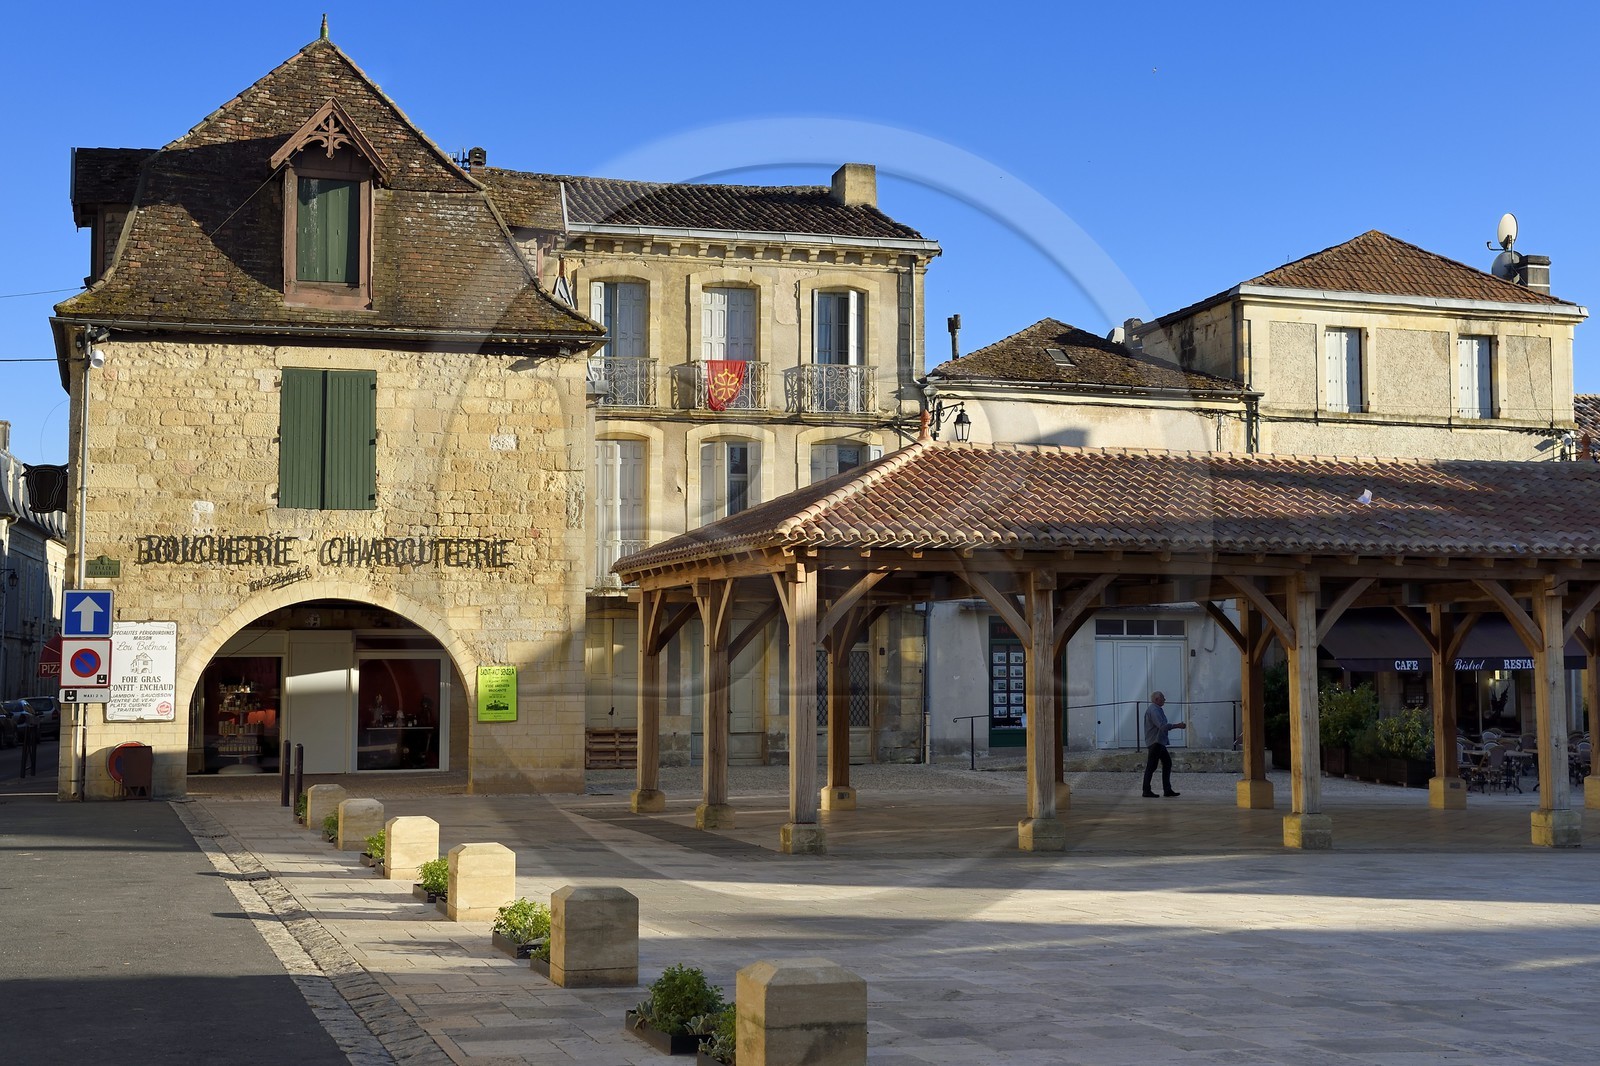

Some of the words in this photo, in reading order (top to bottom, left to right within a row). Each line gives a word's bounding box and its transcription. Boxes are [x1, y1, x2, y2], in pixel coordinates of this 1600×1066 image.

[136, 535, 299, 565] BOUCHERIE
[319, 536, 514, 567] CHARCUTERIE
[1395, 660, 1419, 671] CAFE
